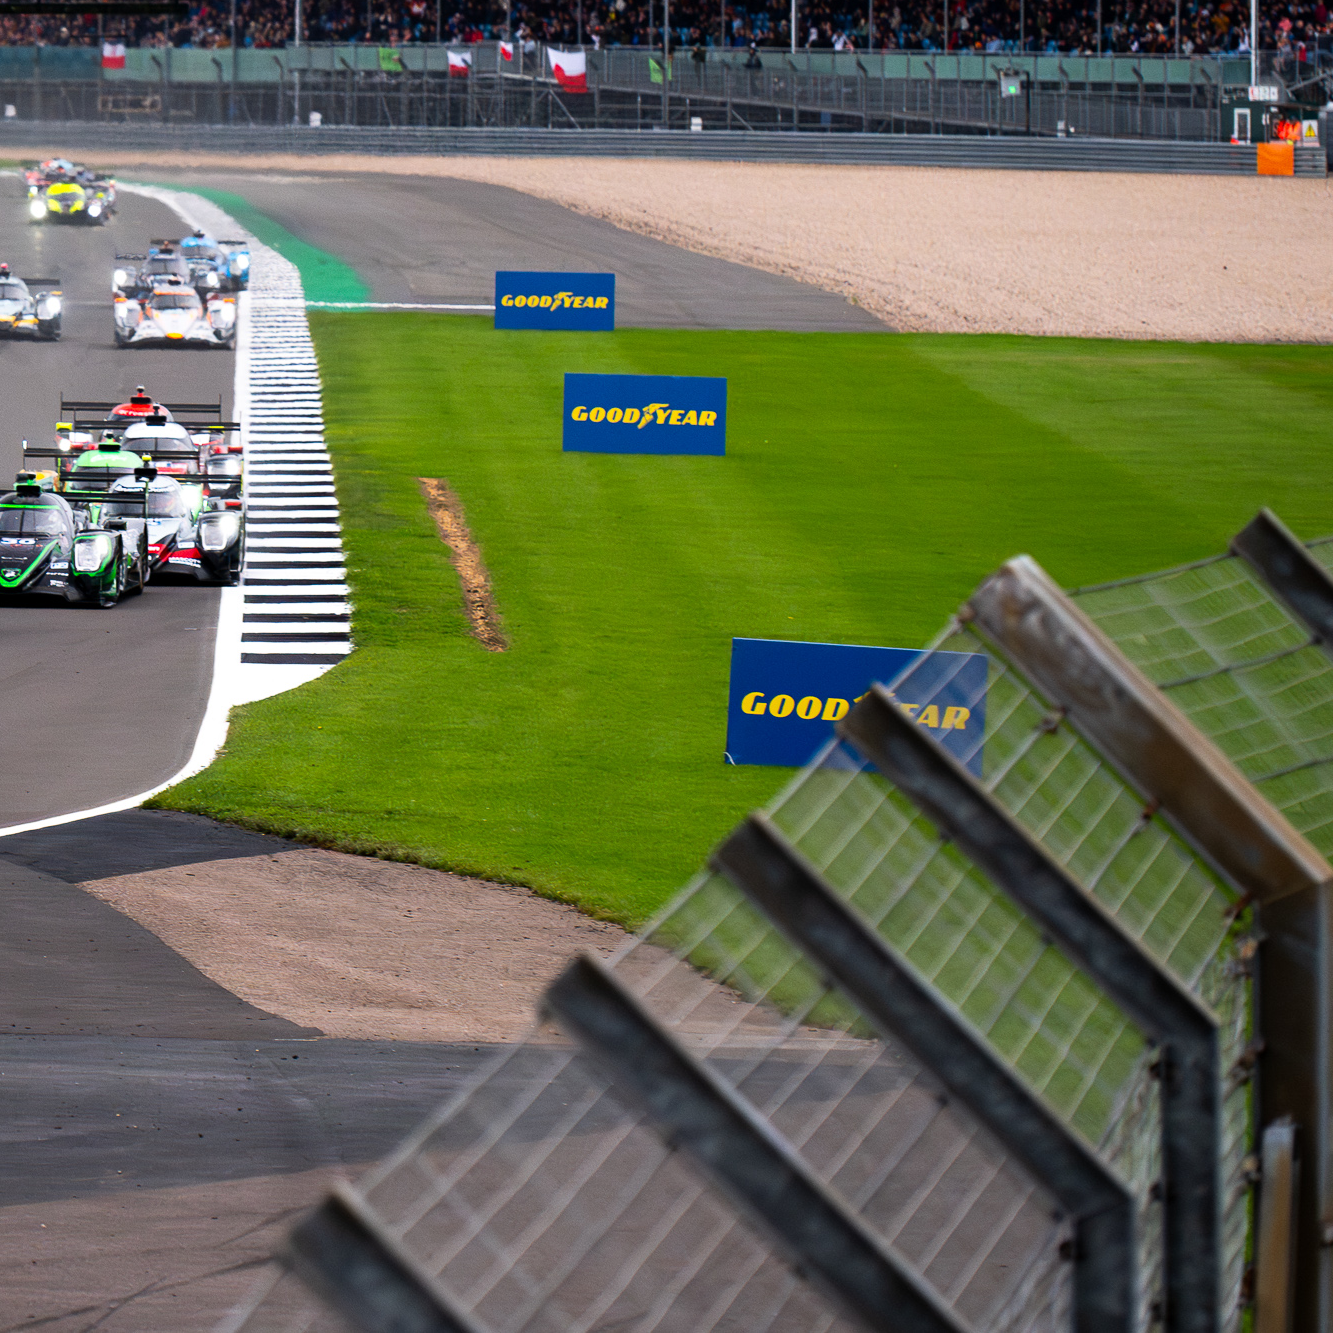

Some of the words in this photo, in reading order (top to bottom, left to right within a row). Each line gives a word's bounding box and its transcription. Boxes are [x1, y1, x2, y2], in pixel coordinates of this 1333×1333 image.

[500, 293, 609, 310] GOODYEAR
[571, 405, 717, 427] GOODYEAR
[740, 691, 971, 731] GOODEAR
